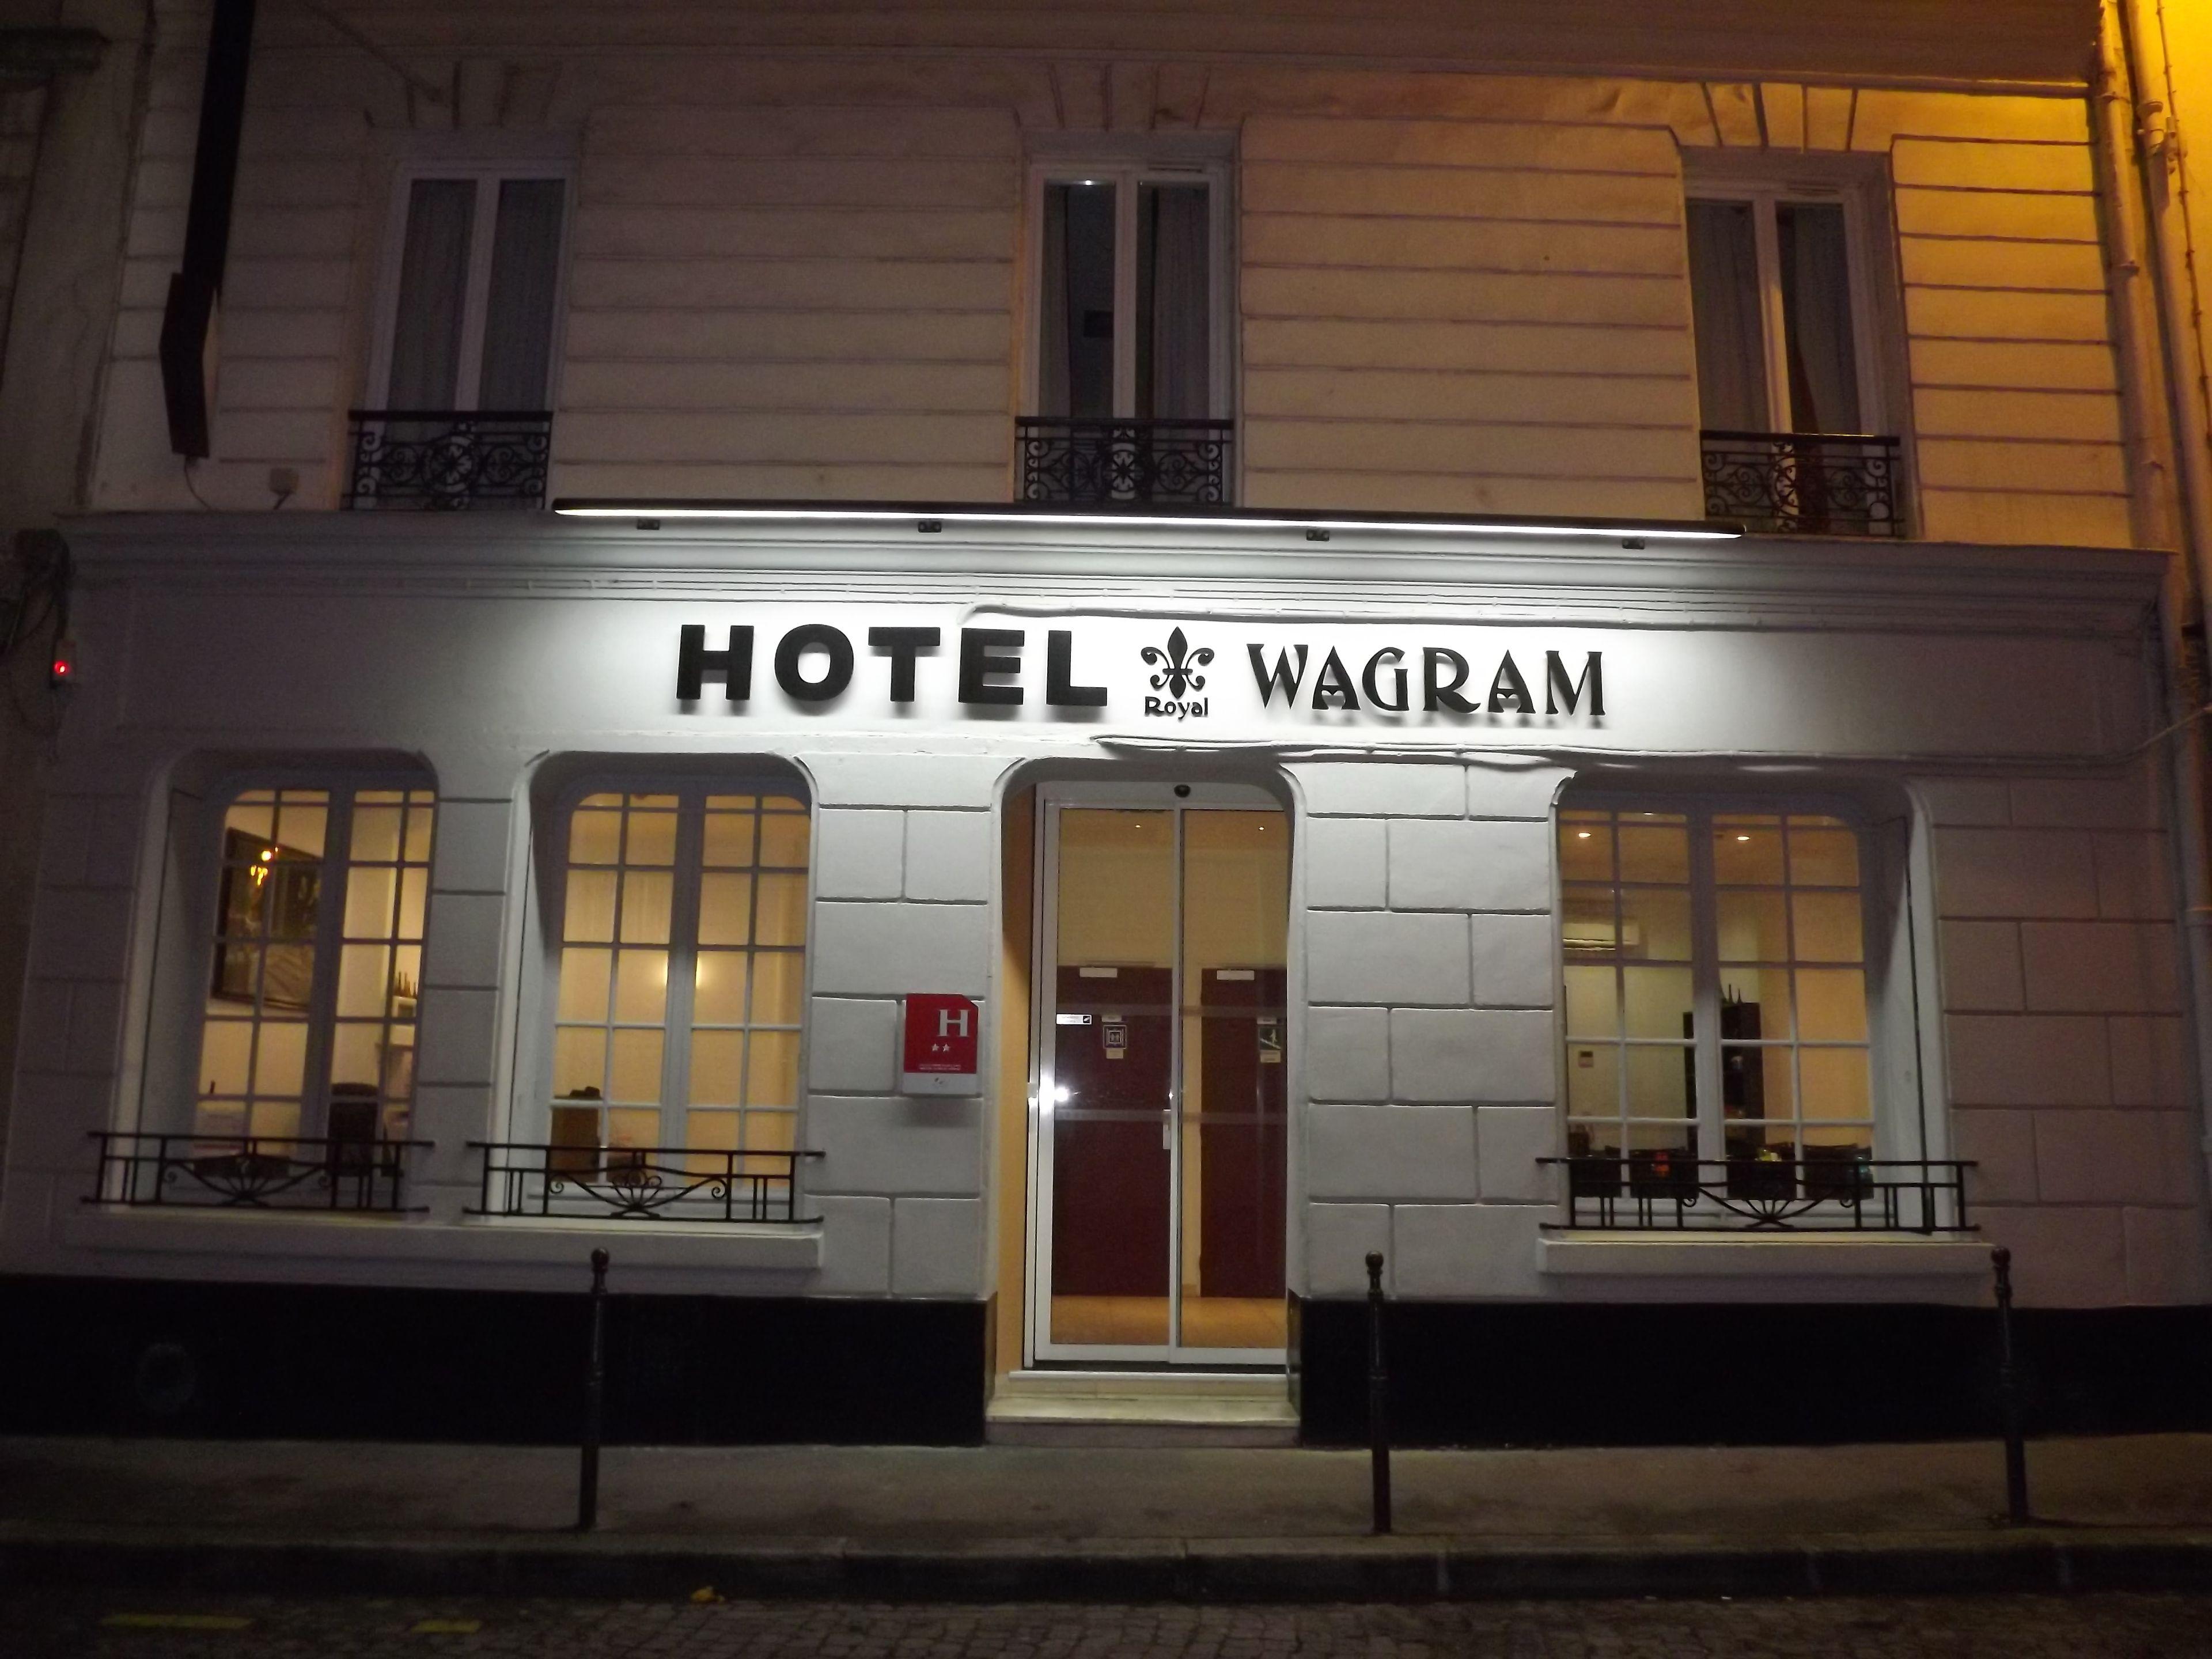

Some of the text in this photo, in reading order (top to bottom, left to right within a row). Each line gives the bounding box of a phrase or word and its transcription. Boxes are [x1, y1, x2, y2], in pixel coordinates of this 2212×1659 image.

[676, 624, 1606, 717] HOTEL WAGRAM
[1145, 696, 1209, 720] Royal
[937, 1009, 970, 1037] H
